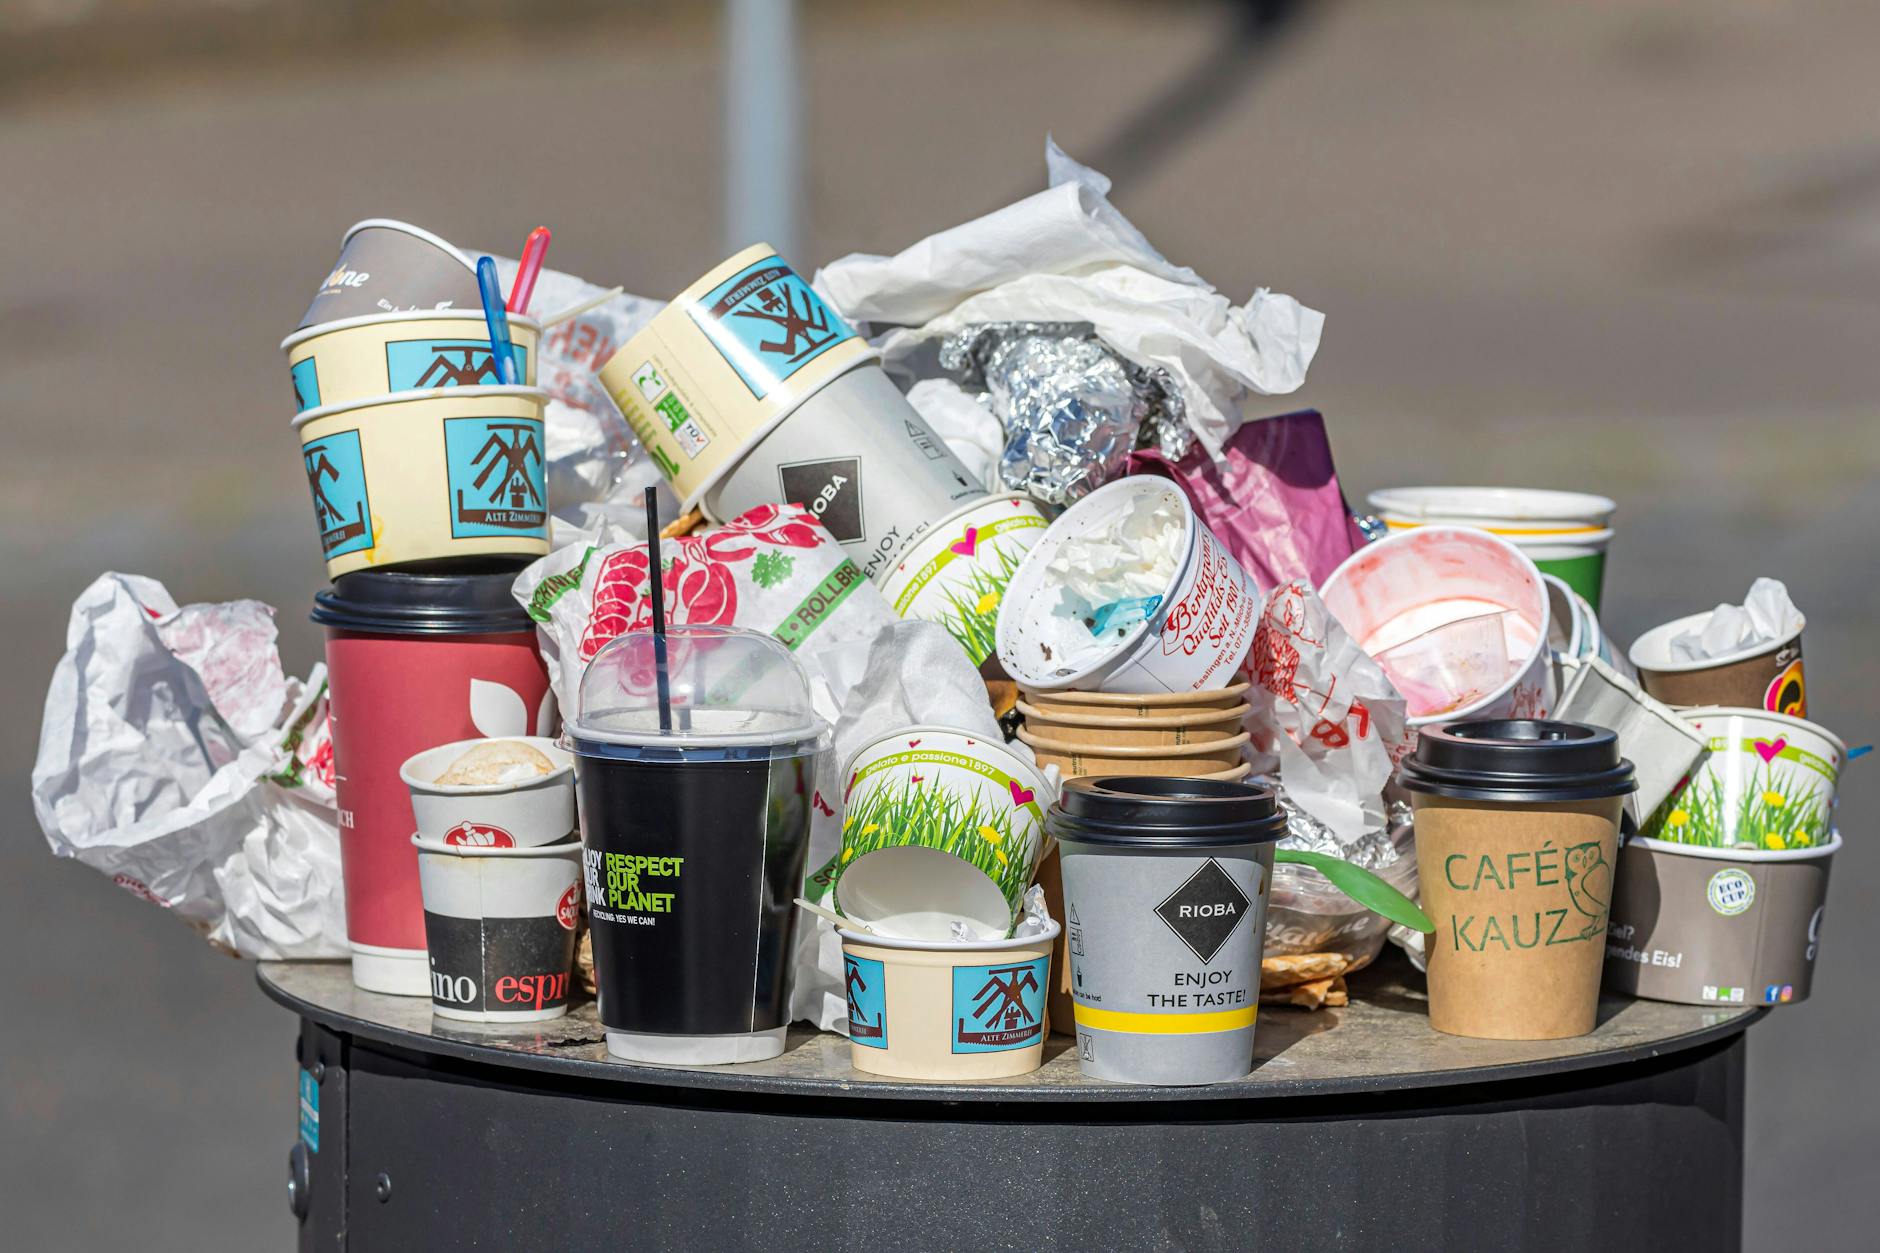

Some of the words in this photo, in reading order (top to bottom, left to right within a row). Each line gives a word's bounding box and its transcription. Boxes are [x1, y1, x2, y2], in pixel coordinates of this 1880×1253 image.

[808, 474, 848, 520] IOBA
[485, 511, 507, 522] ALTE
[864, 525, 900, 579] ENJOY
[1208, 613, 1230, 648] Seit
[1224, 650, 1237, 666] Tel.
[1192, 649, 1227, 690] Esslingen
[865, 756, 898, 777] gelato
[900, 755, 909, 763] e
[605, 852, 684, 877] RESPECT
[1444, 840, 1559, 891] CAFÉ
[607, 870, 640, 893] OUR
[1718, 880, 1742, 894] ECO
[608, 888, 675, 913] PLANET
[1721, 890, 1745, 905] CUP
[615, 914, 627, 924] YES
[627, 915, 638, 925] WE
[1179, 902, 1236, 918] RIOBA
[1452, 908, 1568, 952] KAUZ
[1651, 949, 1683, 969] Eis!
[1174, 969, 1232, 989] ENJOY
[495, 971, 569, 1012] espr
[1147, 994, 1187, 1007] THE
[1193, 989, 1246, 1007] TASTE!
[981, 1034, 1000, 1042] ALTE
